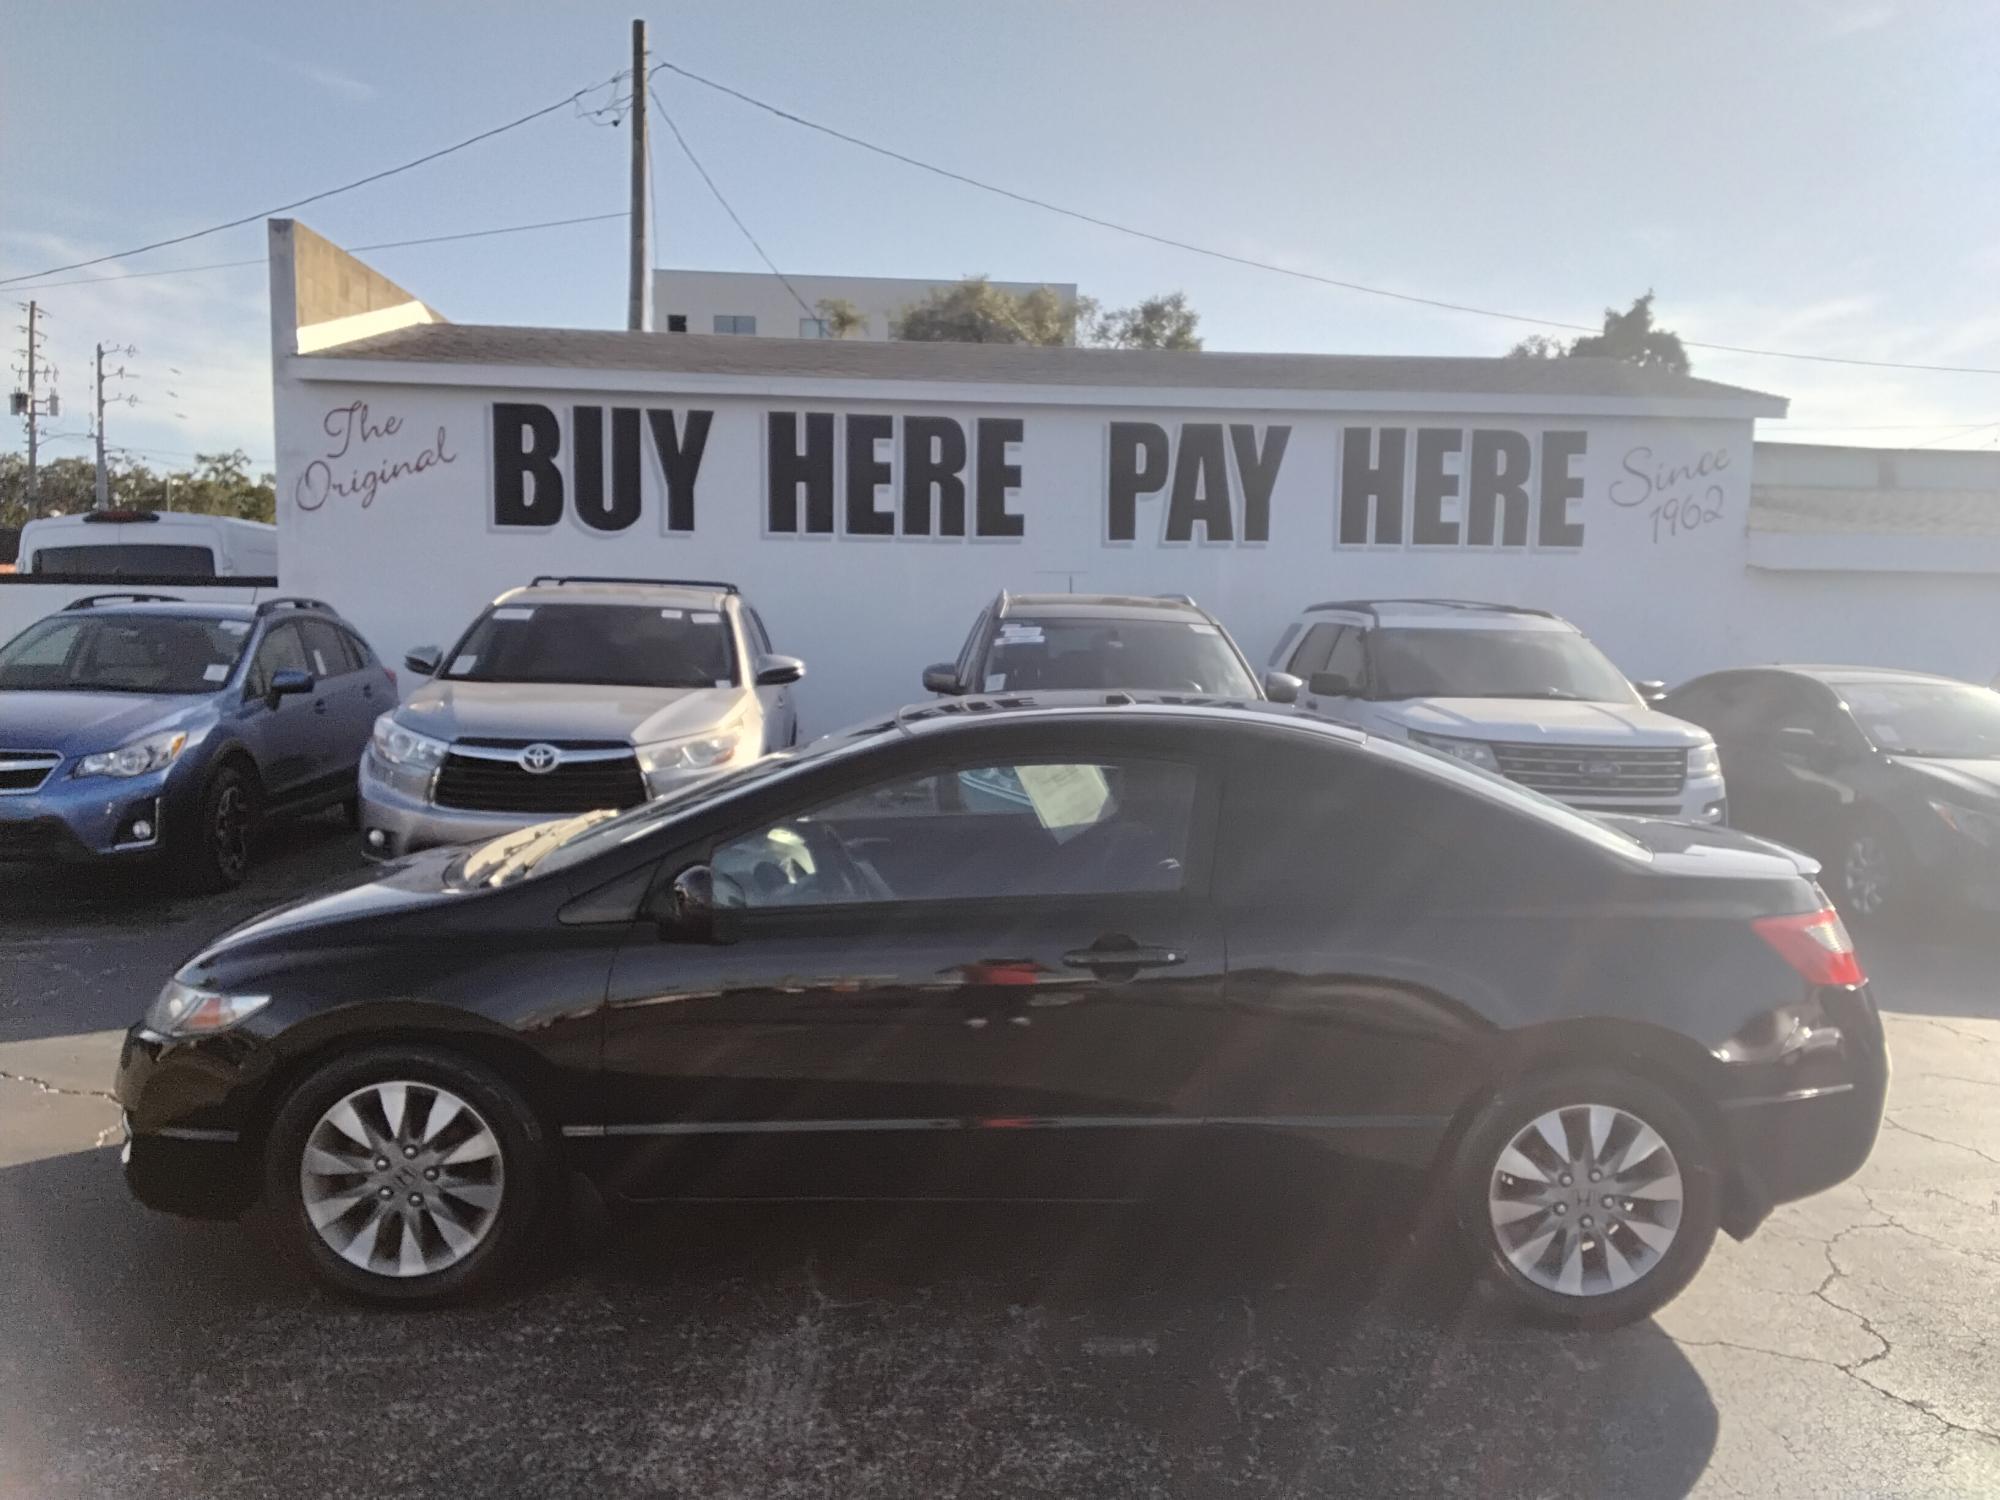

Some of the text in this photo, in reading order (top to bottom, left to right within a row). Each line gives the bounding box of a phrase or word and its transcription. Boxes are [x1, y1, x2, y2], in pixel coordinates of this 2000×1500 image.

[324, 400, 404, 458] The
[295, 427, 457, 511] Original
[493, 403, 1588, 548] BUY HERE PAY HERE
[1609, 447, 1731, 507] Since
[1649, 485, 1725, 543] 1962
